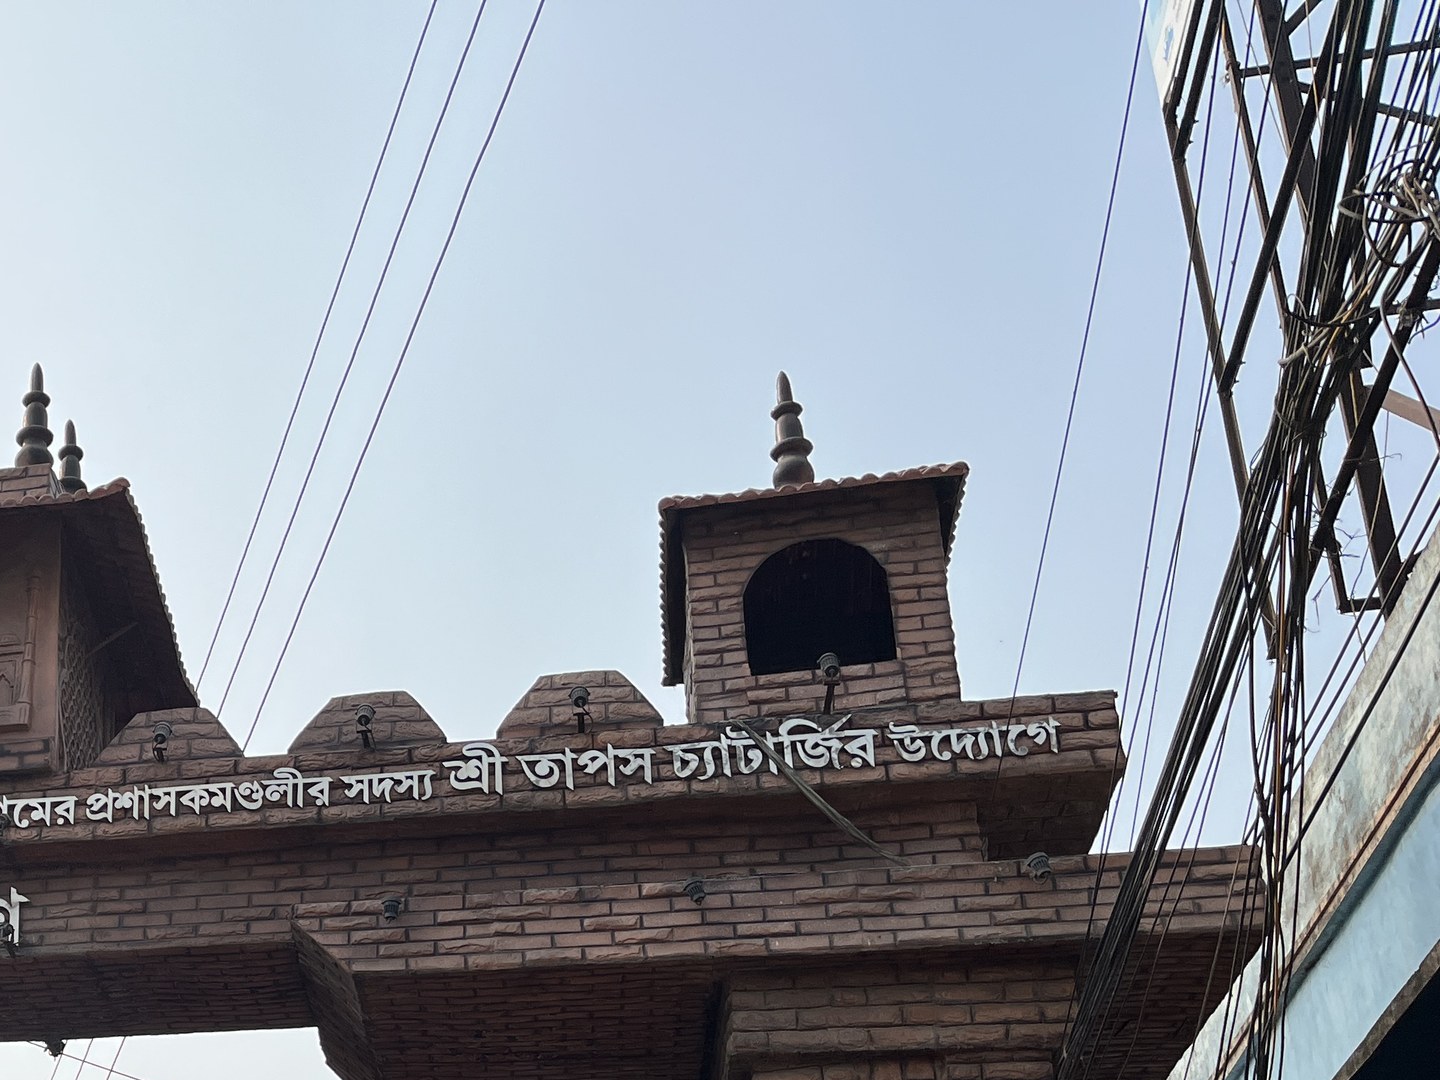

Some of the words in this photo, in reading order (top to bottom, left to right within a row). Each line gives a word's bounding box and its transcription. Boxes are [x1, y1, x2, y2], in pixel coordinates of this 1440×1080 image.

[85, 767, 334, 824] প্রশাসকমণ্ডলীর
[339, 769, 436, 805] সদস্য
[443, 740, 508, 796] শ্রী
[518, 741, 656, 790] তাপস
[662, 714, 878, 781] চ্যাটার্জির
[886, 715, 1062, 763] উদ্যোগে
